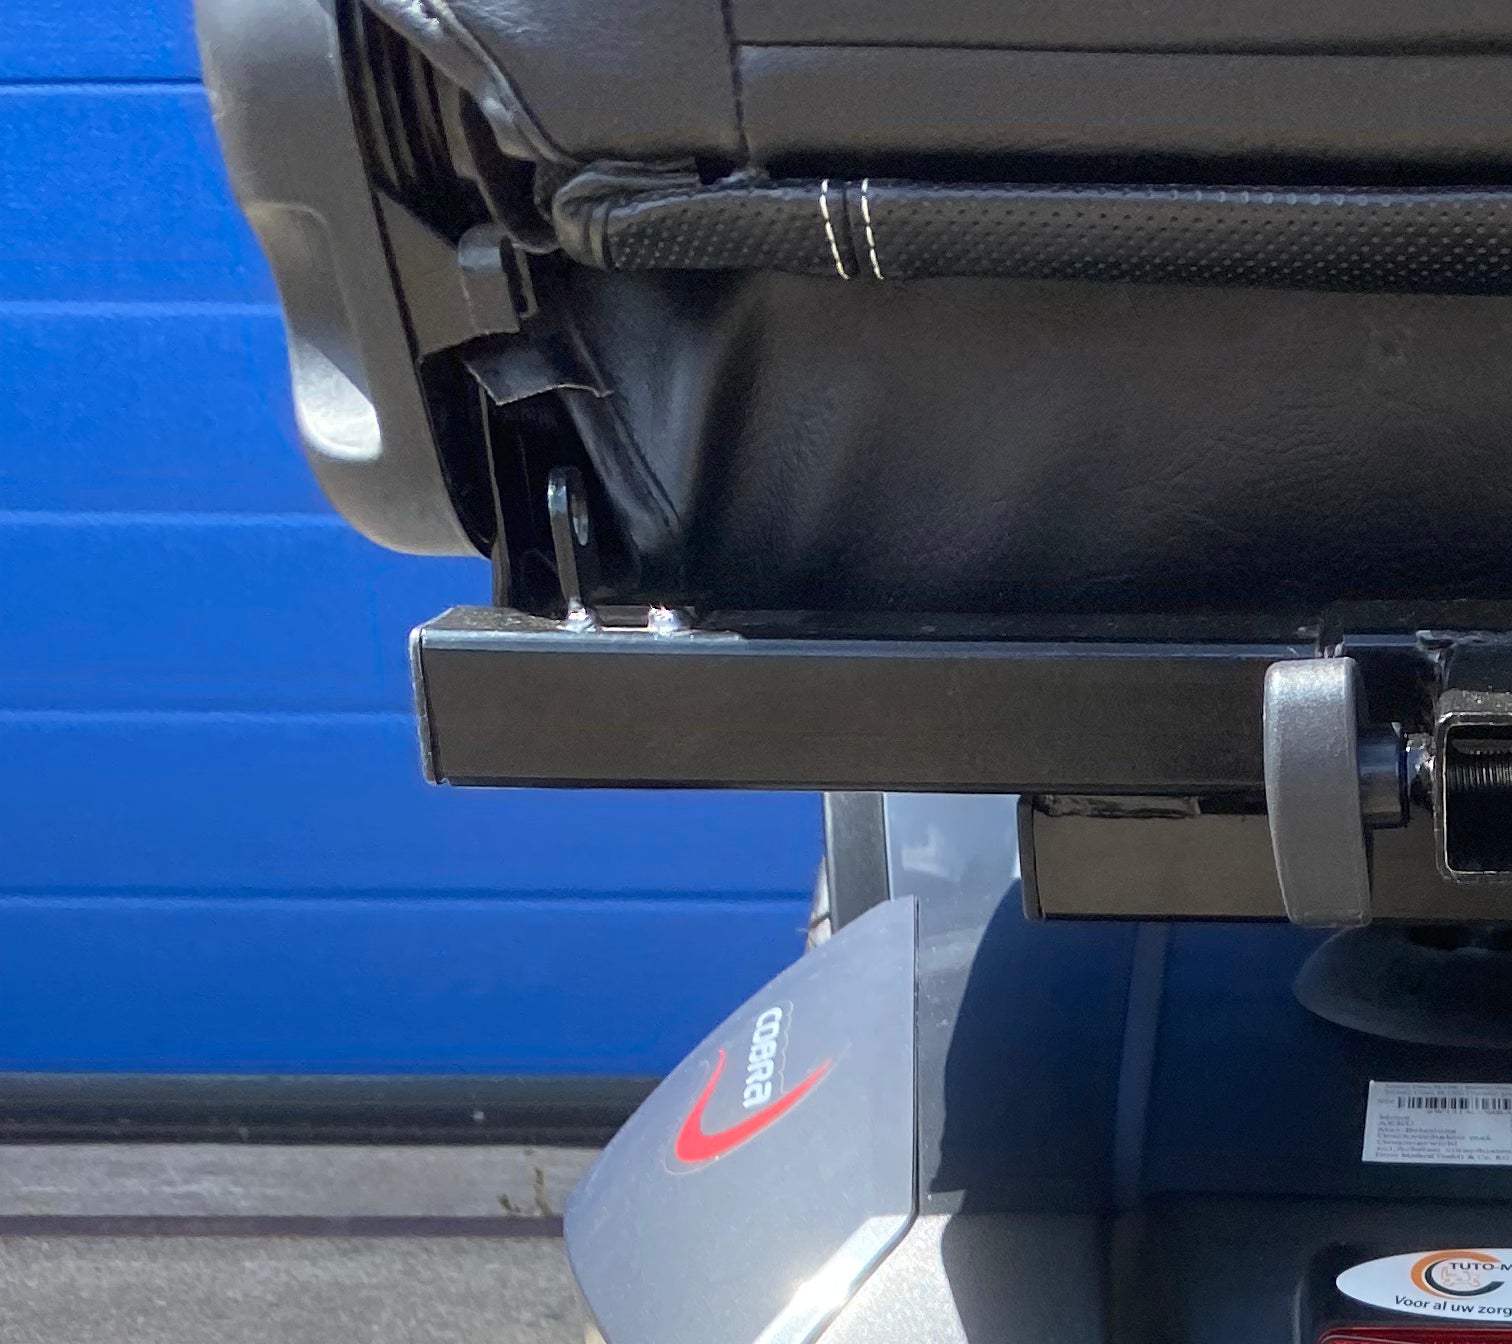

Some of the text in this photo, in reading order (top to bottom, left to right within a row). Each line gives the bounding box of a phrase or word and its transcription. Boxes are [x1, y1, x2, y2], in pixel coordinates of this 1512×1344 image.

[1394, 1295, 1429, 1309] Voor
[1433, 1300, 1447, 1311] al
[1451, 1303, 1474, 1314] uw
